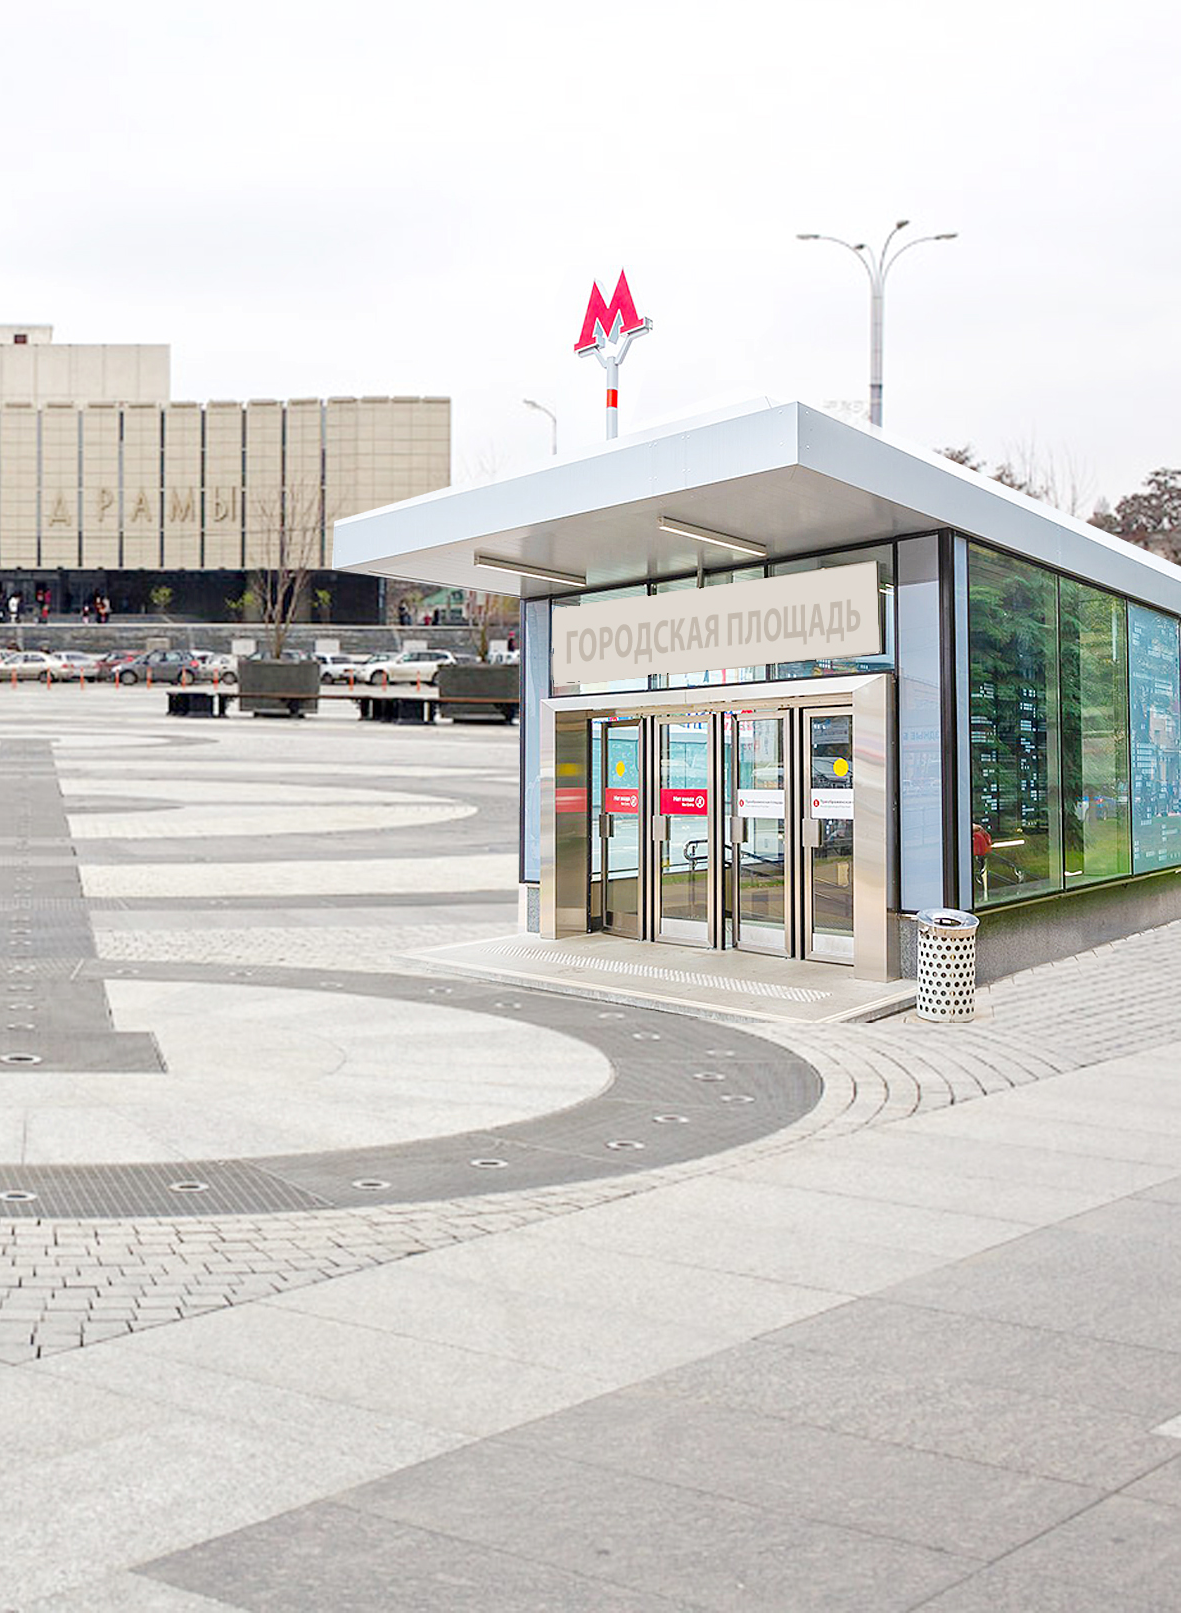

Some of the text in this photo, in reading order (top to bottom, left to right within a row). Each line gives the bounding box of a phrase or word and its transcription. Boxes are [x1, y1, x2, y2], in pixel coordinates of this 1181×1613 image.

[49, 485, 237, 528] ДРАМЫ
[566, 599, 862, 664] ГОРОДСКАЯ ПЛОЩАДЬ
